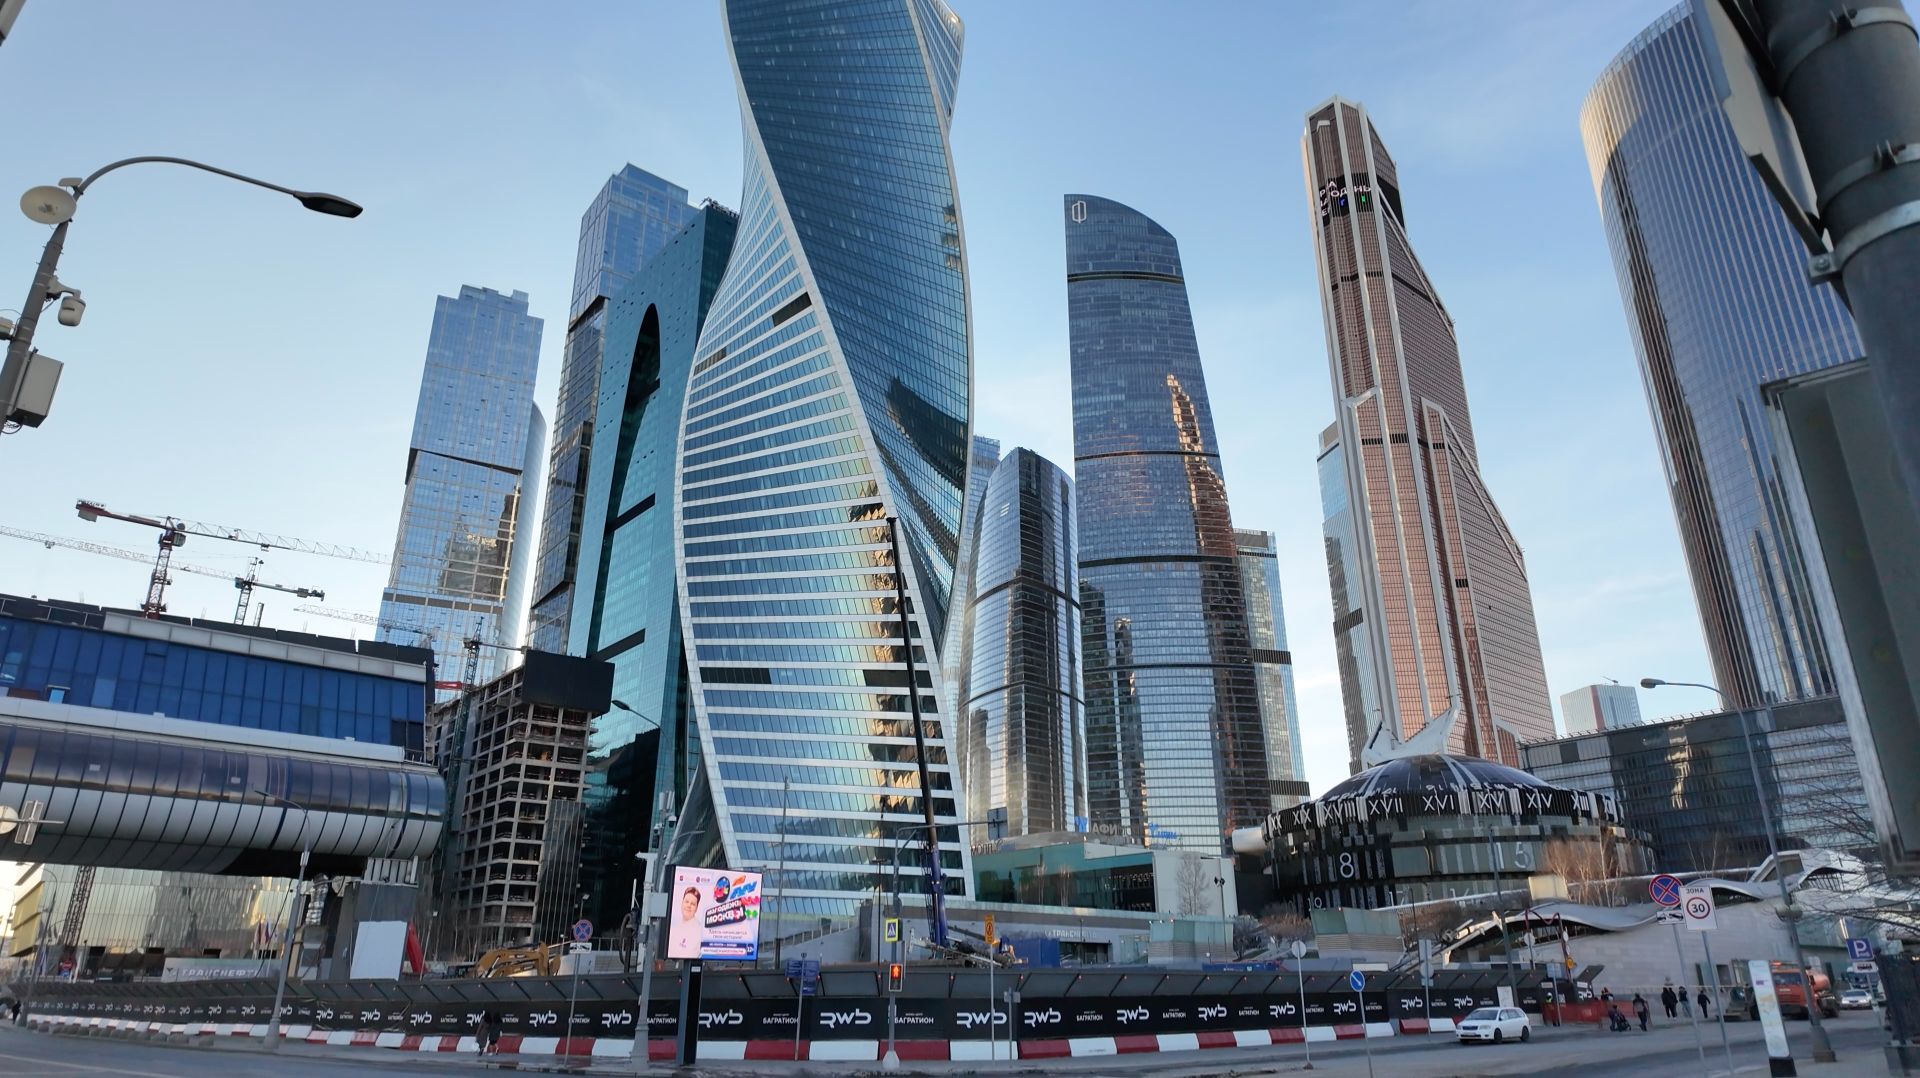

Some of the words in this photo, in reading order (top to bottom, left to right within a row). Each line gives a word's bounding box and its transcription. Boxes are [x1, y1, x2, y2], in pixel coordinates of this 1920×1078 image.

[1691, 903, 1706, 913] 30
[1853, 940, 1868, 958] P
[894, 1017, 934, 1025] БАГРАТИОН
